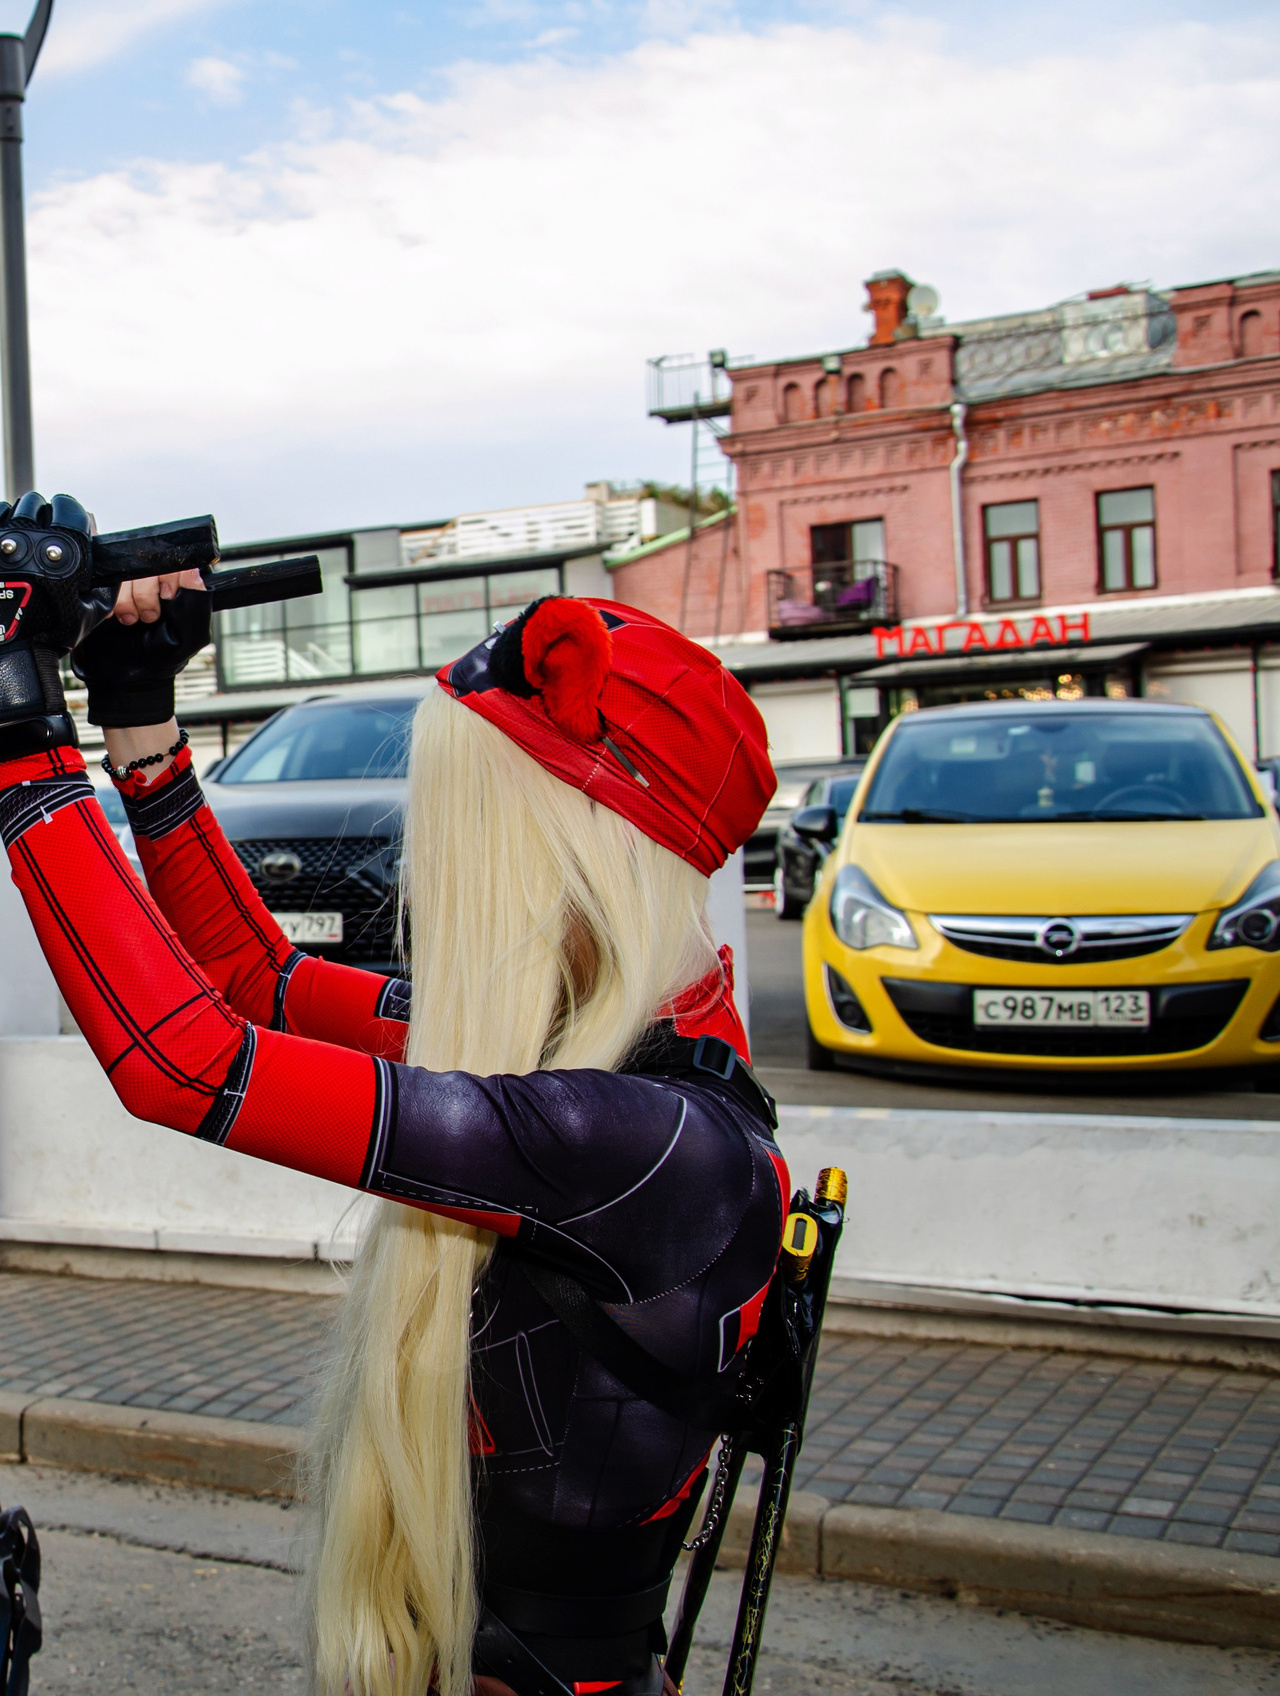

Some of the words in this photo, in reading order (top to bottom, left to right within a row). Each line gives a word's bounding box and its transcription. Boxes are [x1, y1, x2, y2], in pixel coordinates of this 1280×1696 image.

[871, 612, 1090, 659] МАГАДАН
[305, 916, 336, 931] 797
[1102, 995, 1143, 1014] 123
